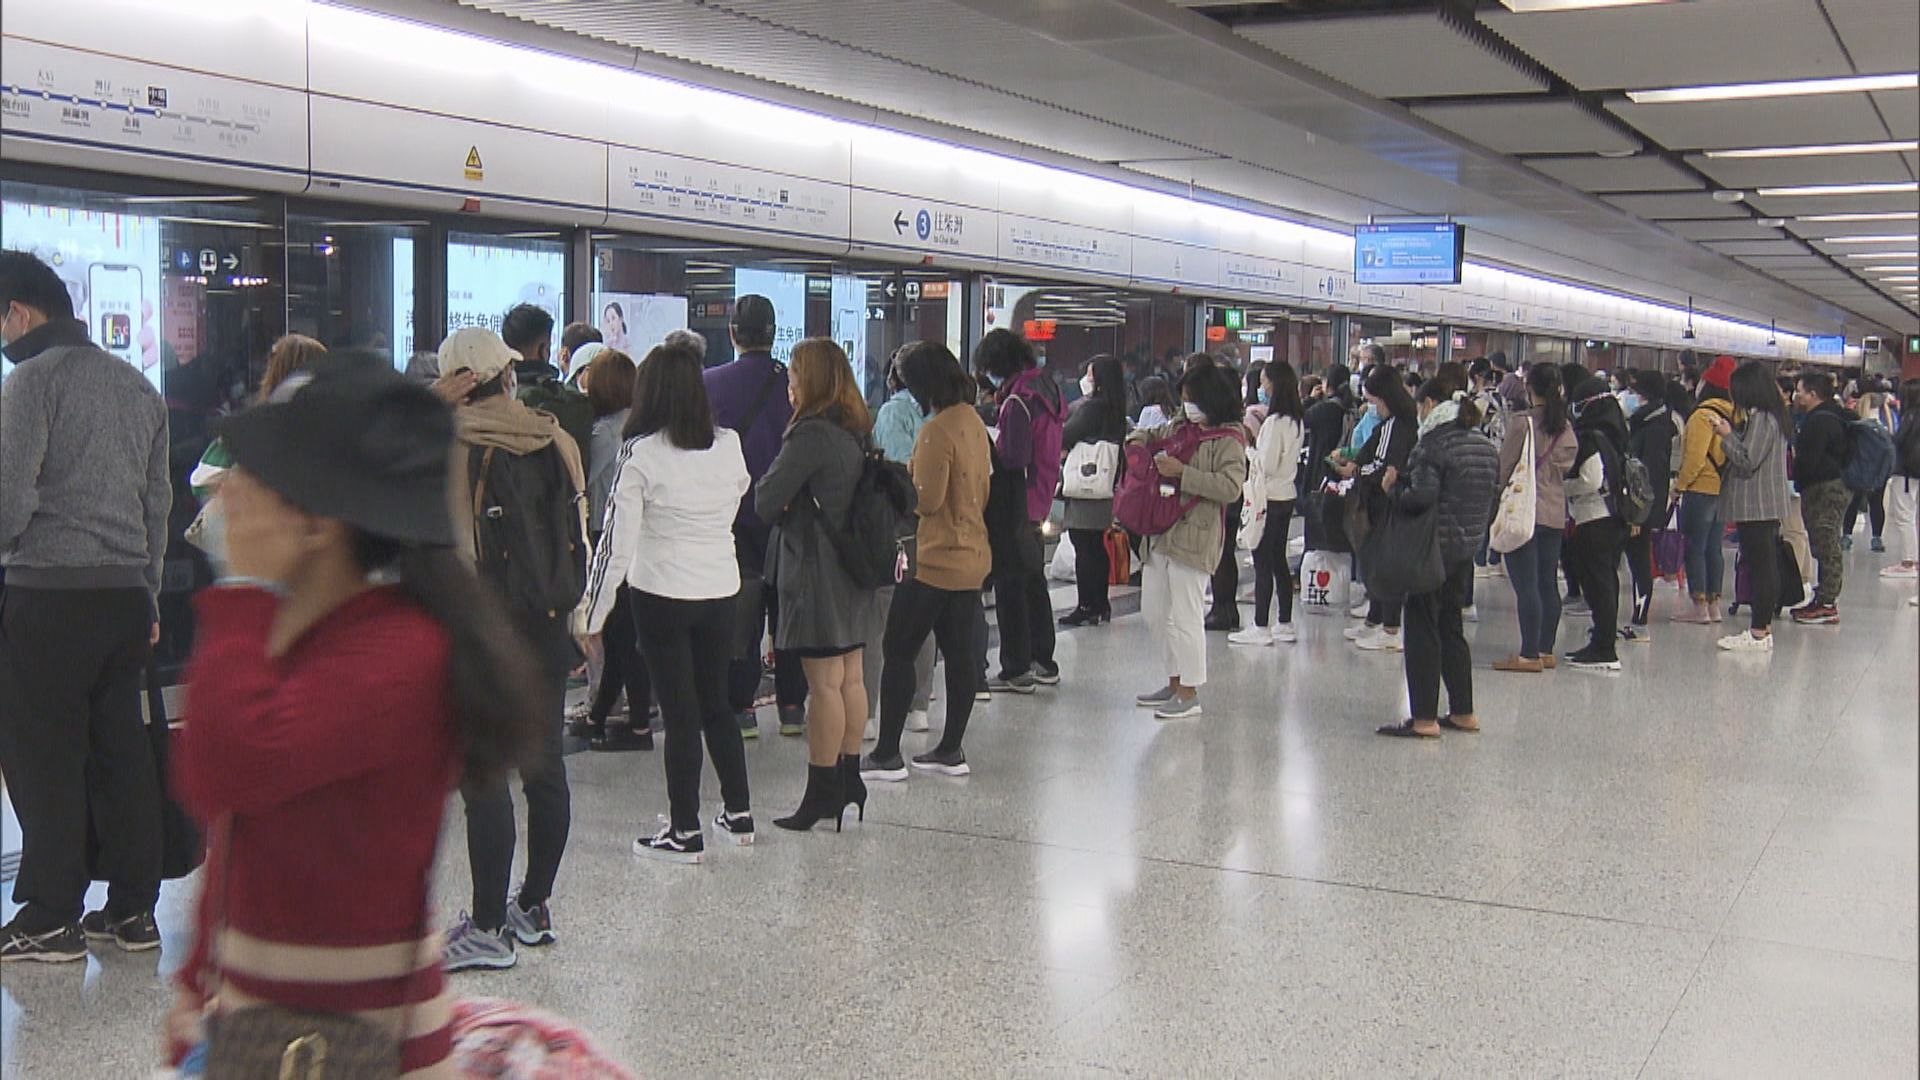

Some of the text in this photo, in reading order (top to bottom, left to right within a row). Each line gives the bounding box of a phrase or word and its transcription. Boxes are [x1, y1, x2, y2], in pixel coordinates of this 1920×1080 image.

[920, 214, 927, 236] 3
[1308, 570, 1316, 587] I
[1308, 589, 1330, 605] HK
